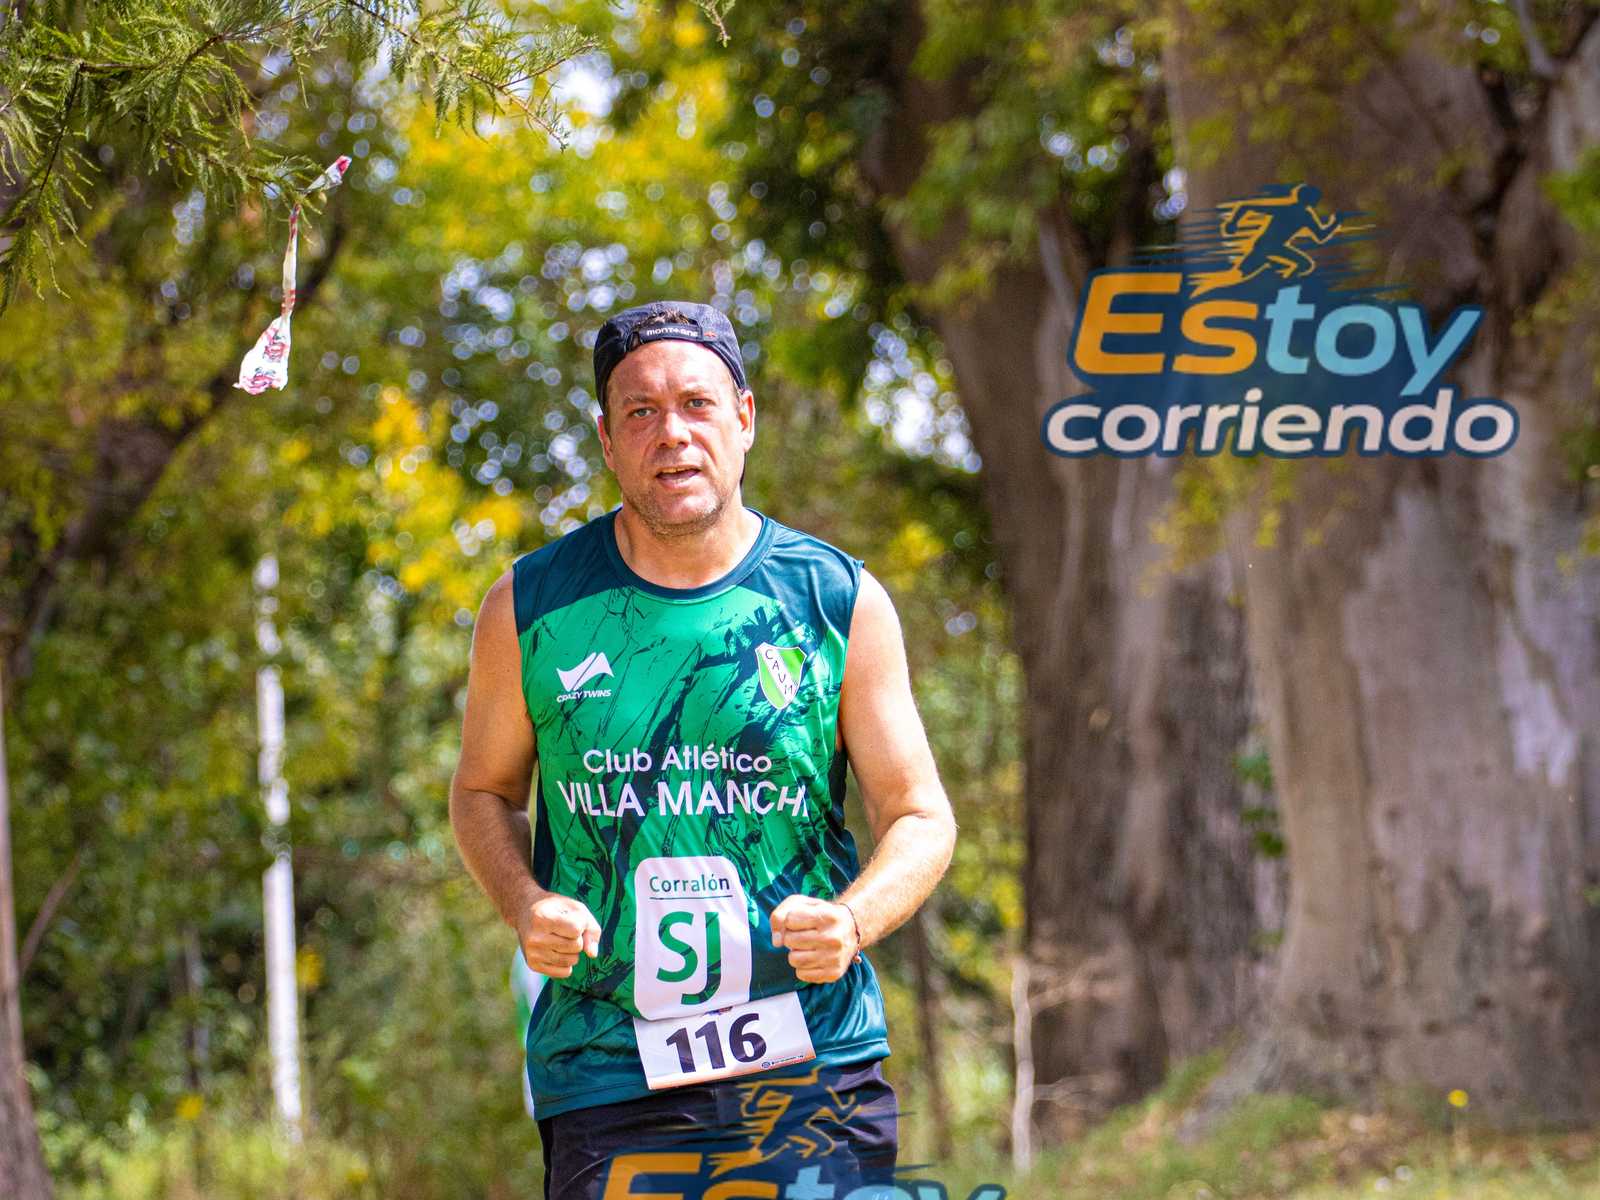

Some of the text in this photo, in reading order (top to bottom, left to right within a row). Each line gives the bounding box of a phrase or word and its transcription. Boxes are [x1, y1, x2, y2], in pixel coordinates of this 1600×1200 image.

[556, 689, 612, 703] CRAZY TWINS
[583, 744, 772, 774] Club Atlético
[556, 781, 646, 818] VILLA
[649, 874, 730, 893] Corralón
[656, 911, 722, 1006] SJ
[665, 1012, 768, 1074] 116
